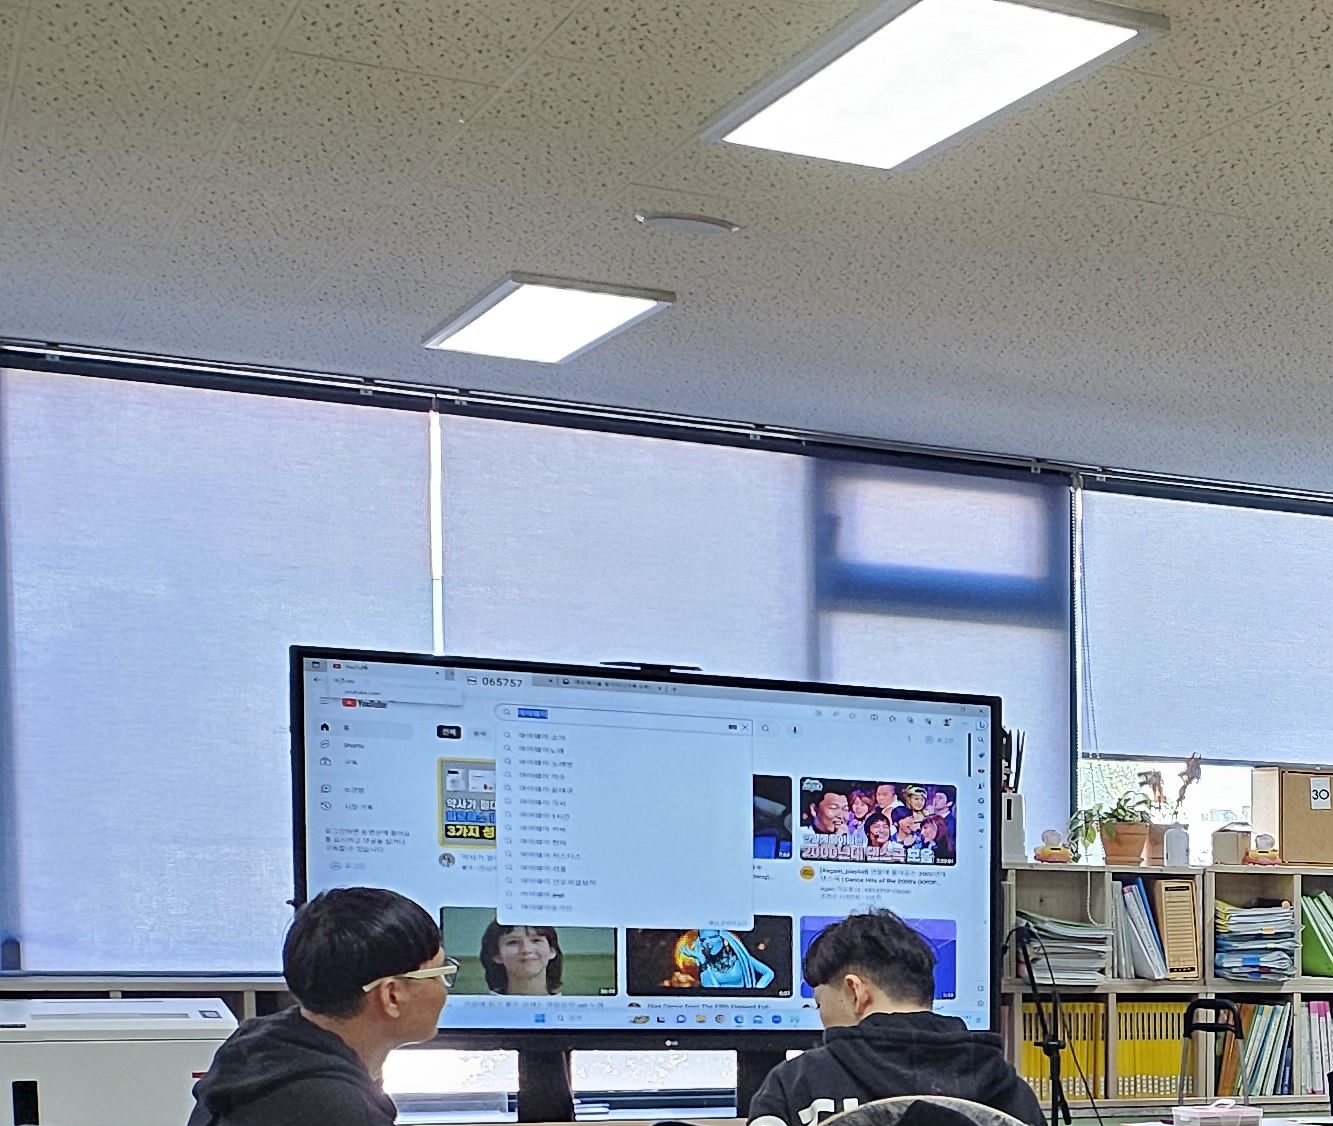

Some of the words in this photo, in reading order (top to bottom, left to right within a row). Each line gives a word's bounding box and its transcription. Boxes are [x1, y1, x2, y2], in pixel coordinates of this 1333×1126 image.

[482, 677, 523, 688] 065757
[1311, 788, 1330, 801] 30
[447, 825, 480, 838] 3가지
